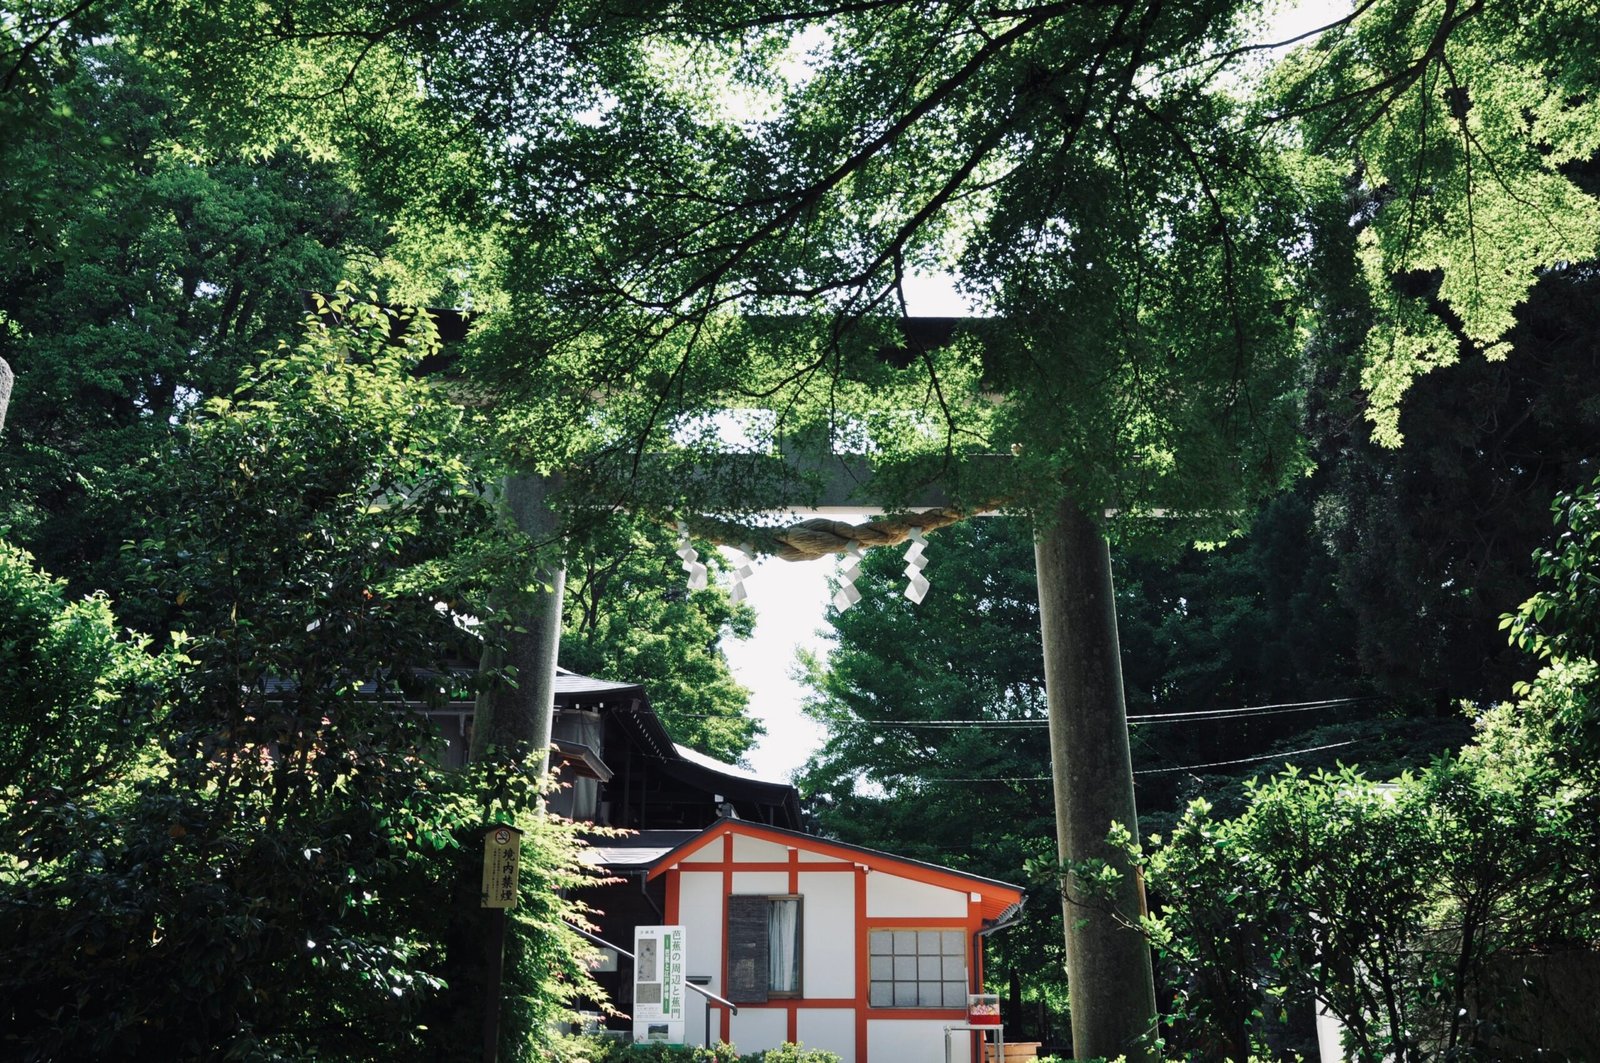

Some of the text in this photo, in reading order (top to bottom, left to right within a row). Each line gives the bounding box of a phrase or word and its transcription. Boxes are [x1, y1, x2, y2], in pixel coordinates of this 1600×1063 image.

[500, 847, 515, 902] 境内禁煙
[671, 930, 681, 1019] 芭蕉の周辺と蕉門
